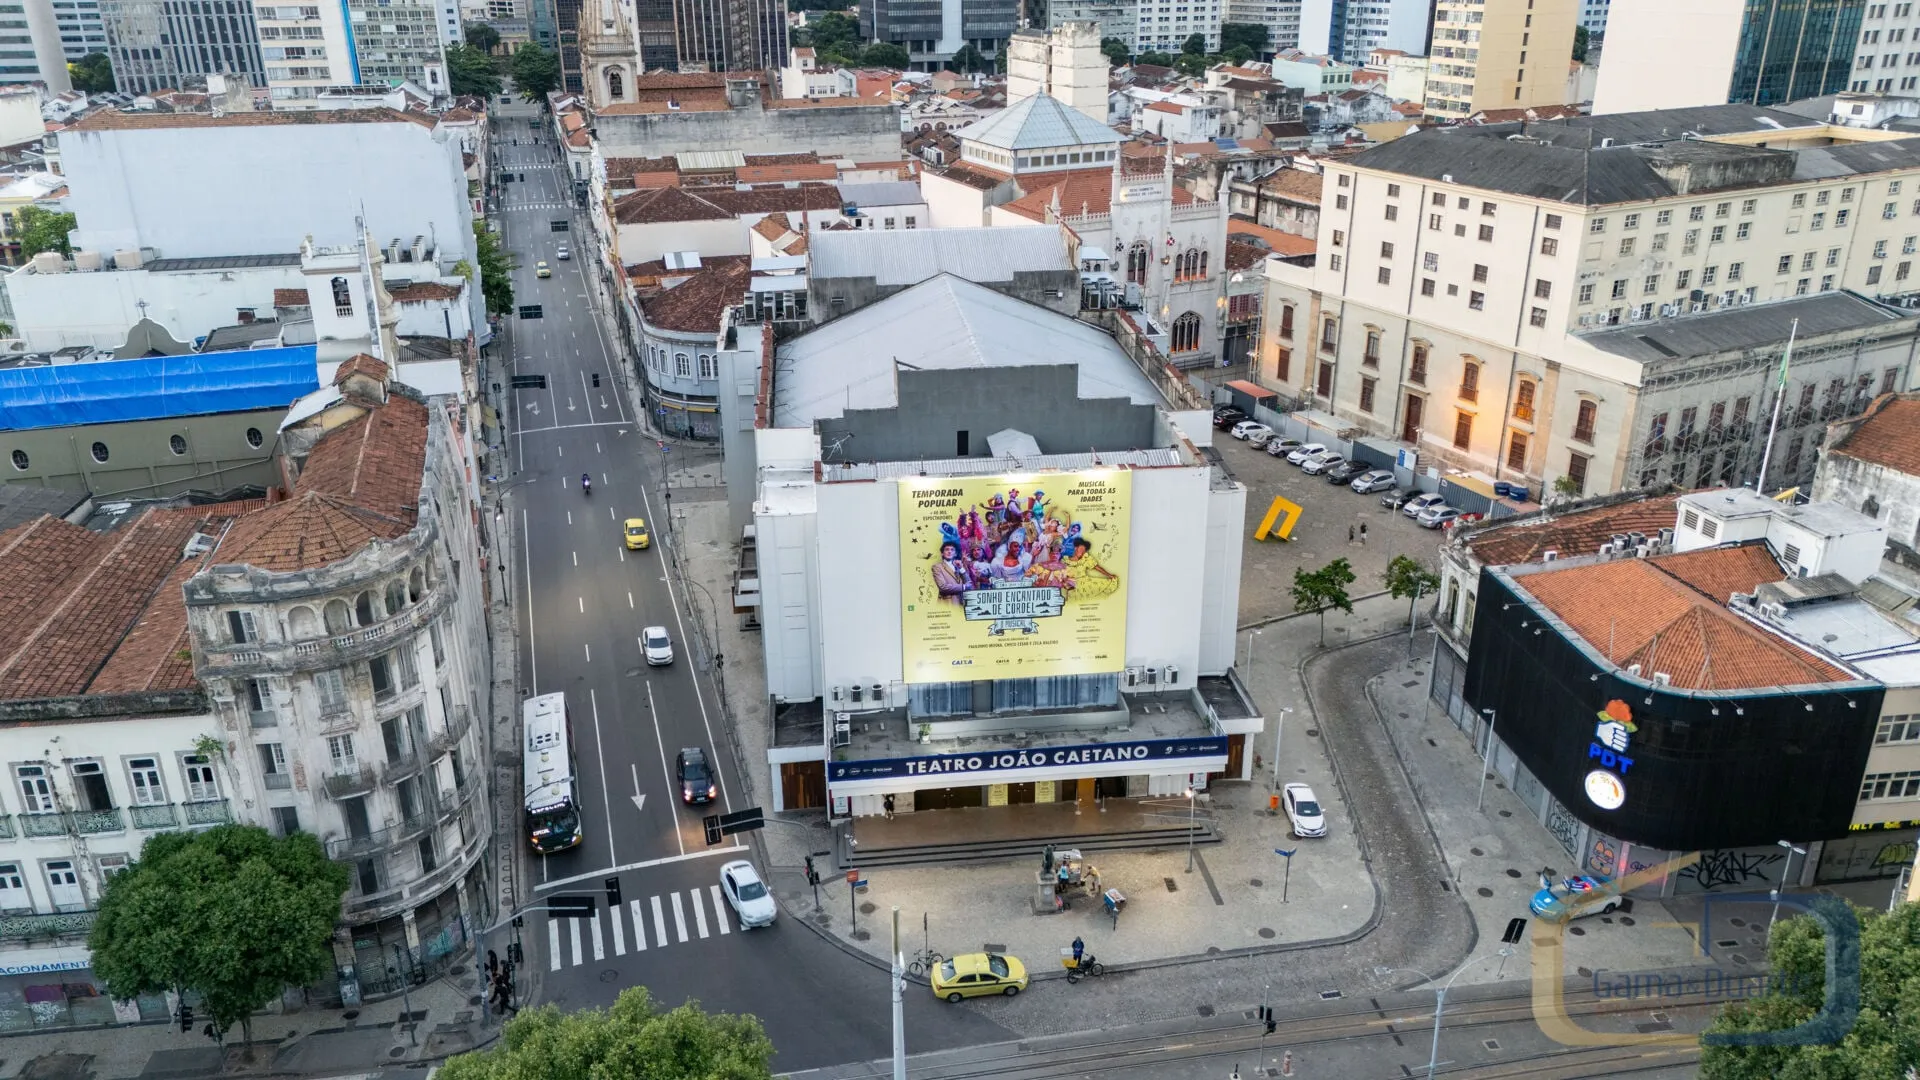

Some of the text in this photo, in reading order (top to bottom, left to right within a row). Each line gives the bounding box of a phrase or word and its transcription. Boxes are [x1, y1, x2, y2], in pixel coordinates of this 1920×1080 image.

[912, 488, 964, 498] TEMPORADA
[918, 499, 957, 508] POPULAR
[976, 590, 1051, 604] SONHO ENCANTADO
[992, 602, 1035, 615] DE CORDEL
[906, 746, 1148, 774] TEATRO JOÃO CAETANO
[1589, 743, 1634, 774] PDT
